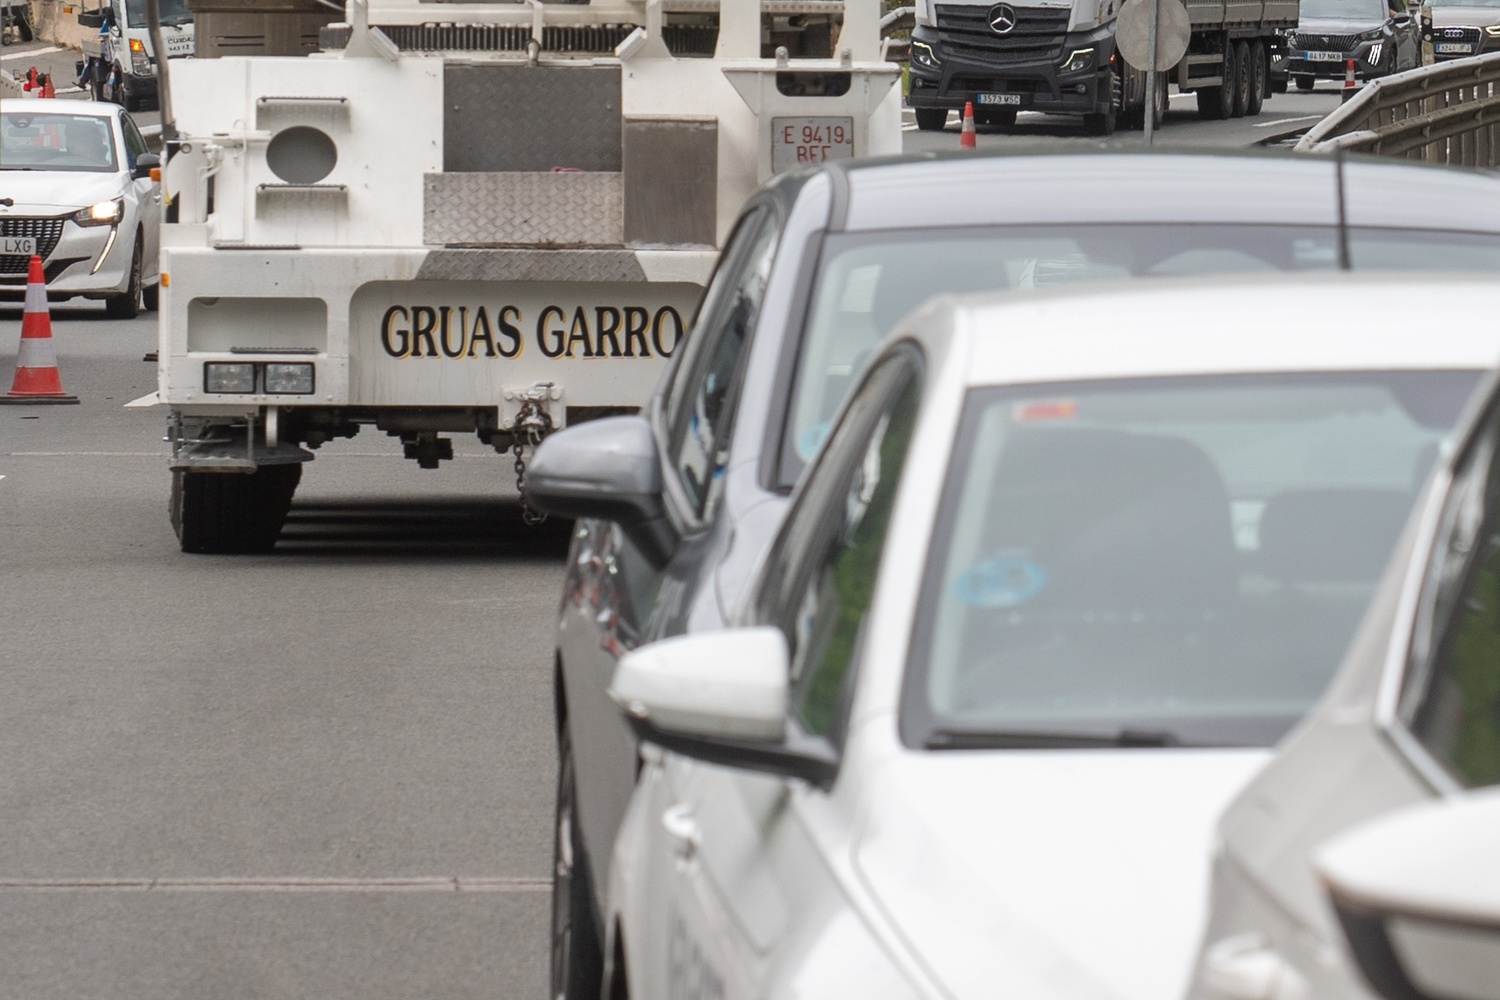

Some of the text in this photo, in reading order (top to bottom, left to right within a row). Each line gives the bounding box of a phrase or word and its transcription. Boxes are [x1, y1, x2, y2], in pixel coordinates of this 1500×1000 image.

[783, 125, 844, 144] E 9419
[5, 239, 32, 253] LXG
[380, 305, 688, 360] GRUAS GARRO
